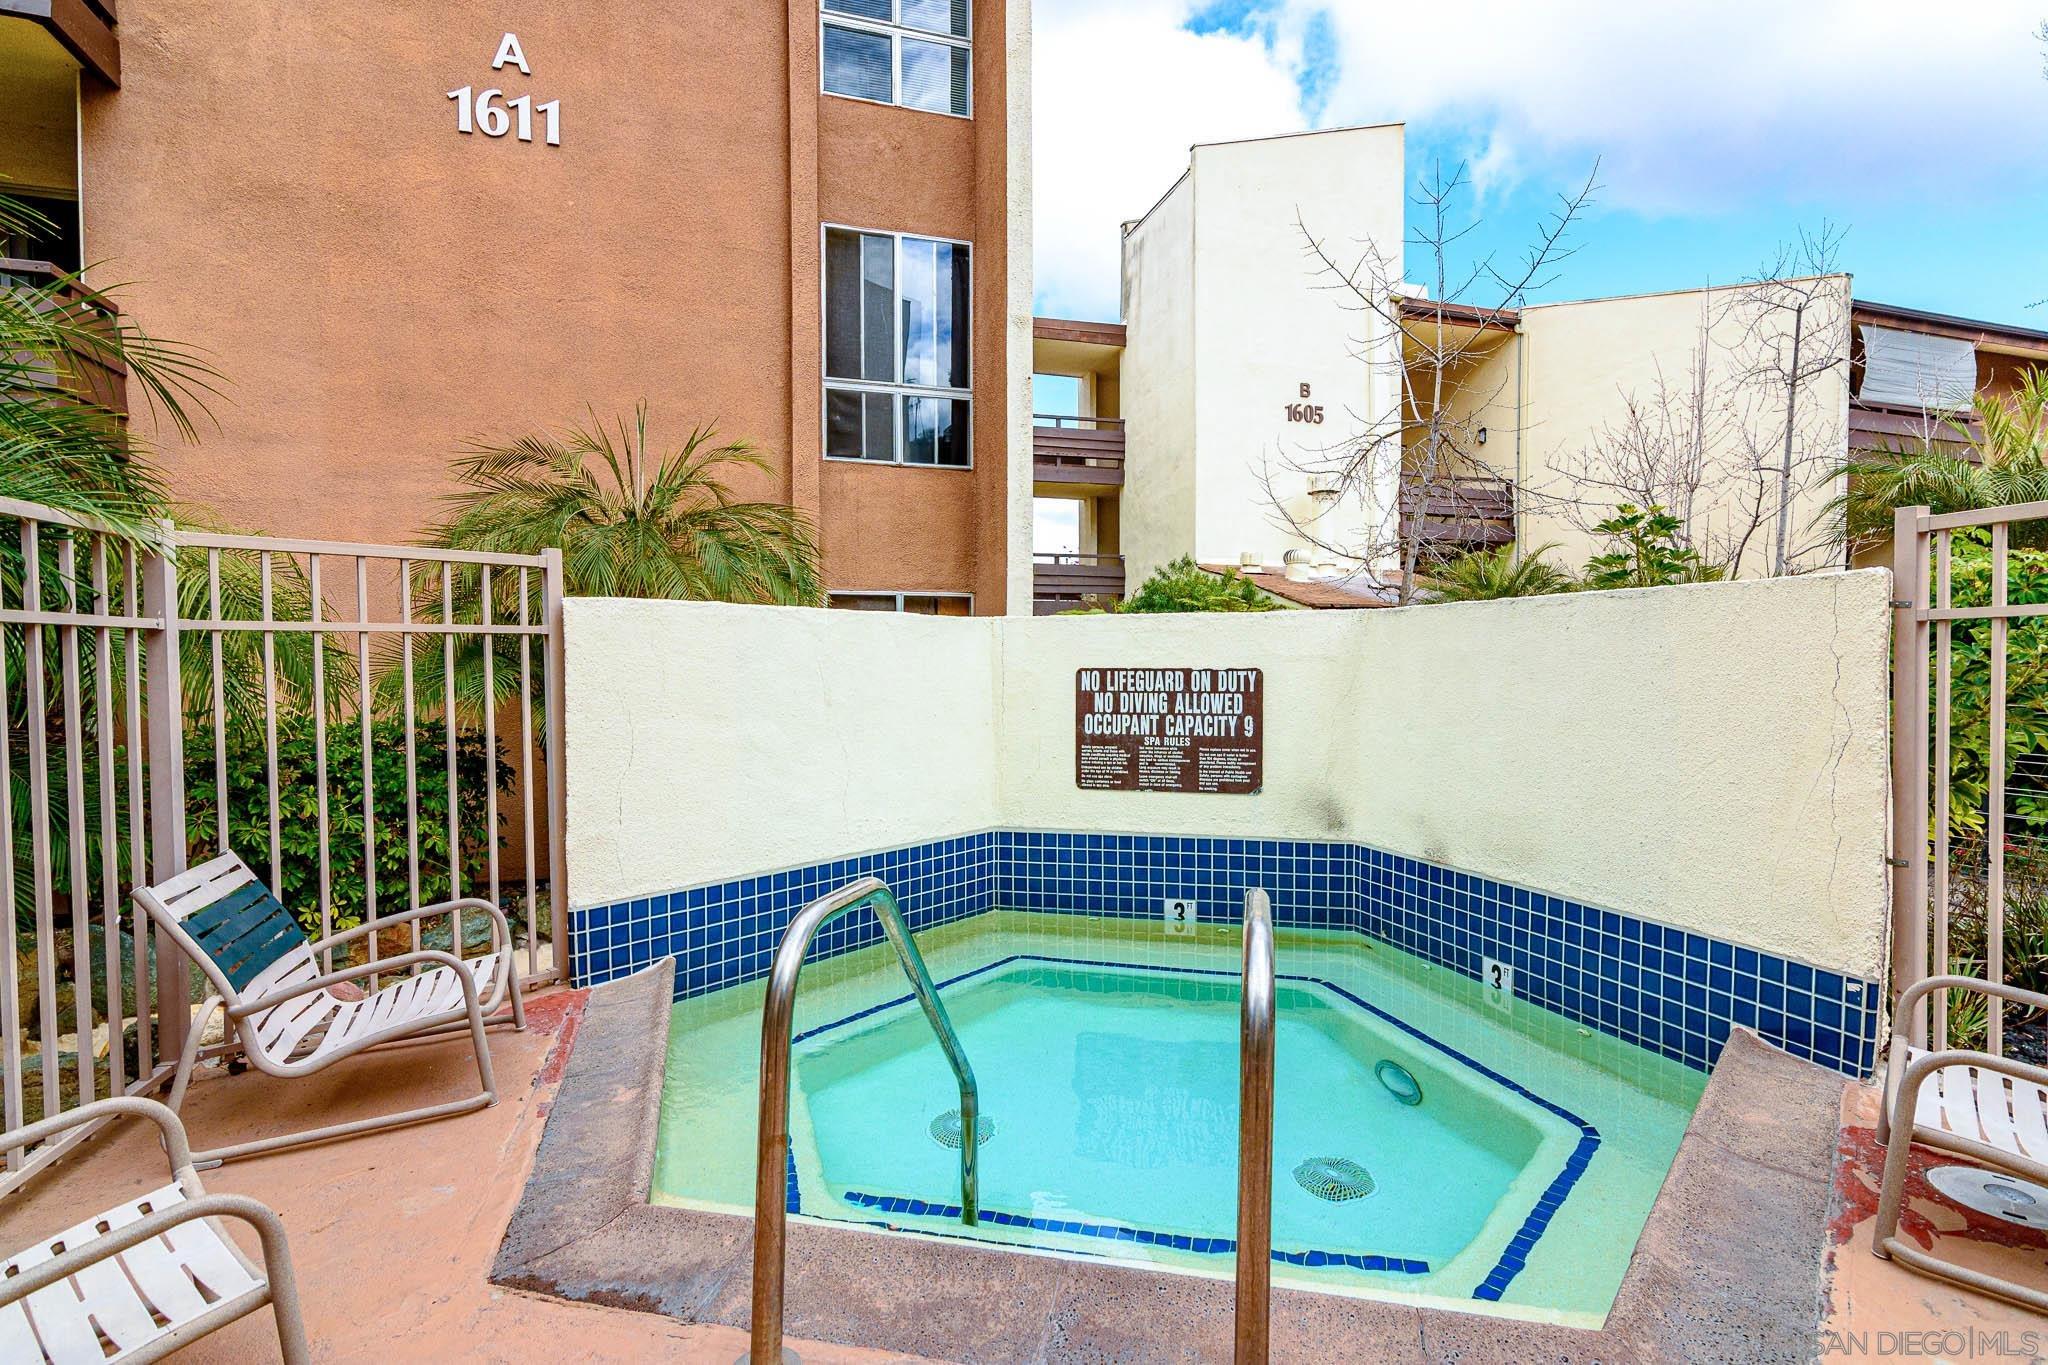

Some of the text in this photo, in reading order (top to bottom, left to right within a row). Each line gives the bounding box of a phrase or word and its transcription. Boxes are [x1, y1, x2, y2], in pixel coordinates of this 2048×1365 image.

[491, 32, 532, 75] A
[446, 85, 561, 147] 1611
[1299, 382, 1311, 398] B
[1284, 403, 1325, 425] 1605
[1081, 671, 1257, 692] NO LIFEGUARD ON DUTY
[1094, 693, 1243, 715] NO DIVING ALLOWED
[1084, 714, 1254, 738] OCCUPANT CAPACITY 9
[1144, 737, 1191, 747] SPA RULES
[1174, 902, 1186, 921] 3
[1491, 964, 1502, 990] 3
